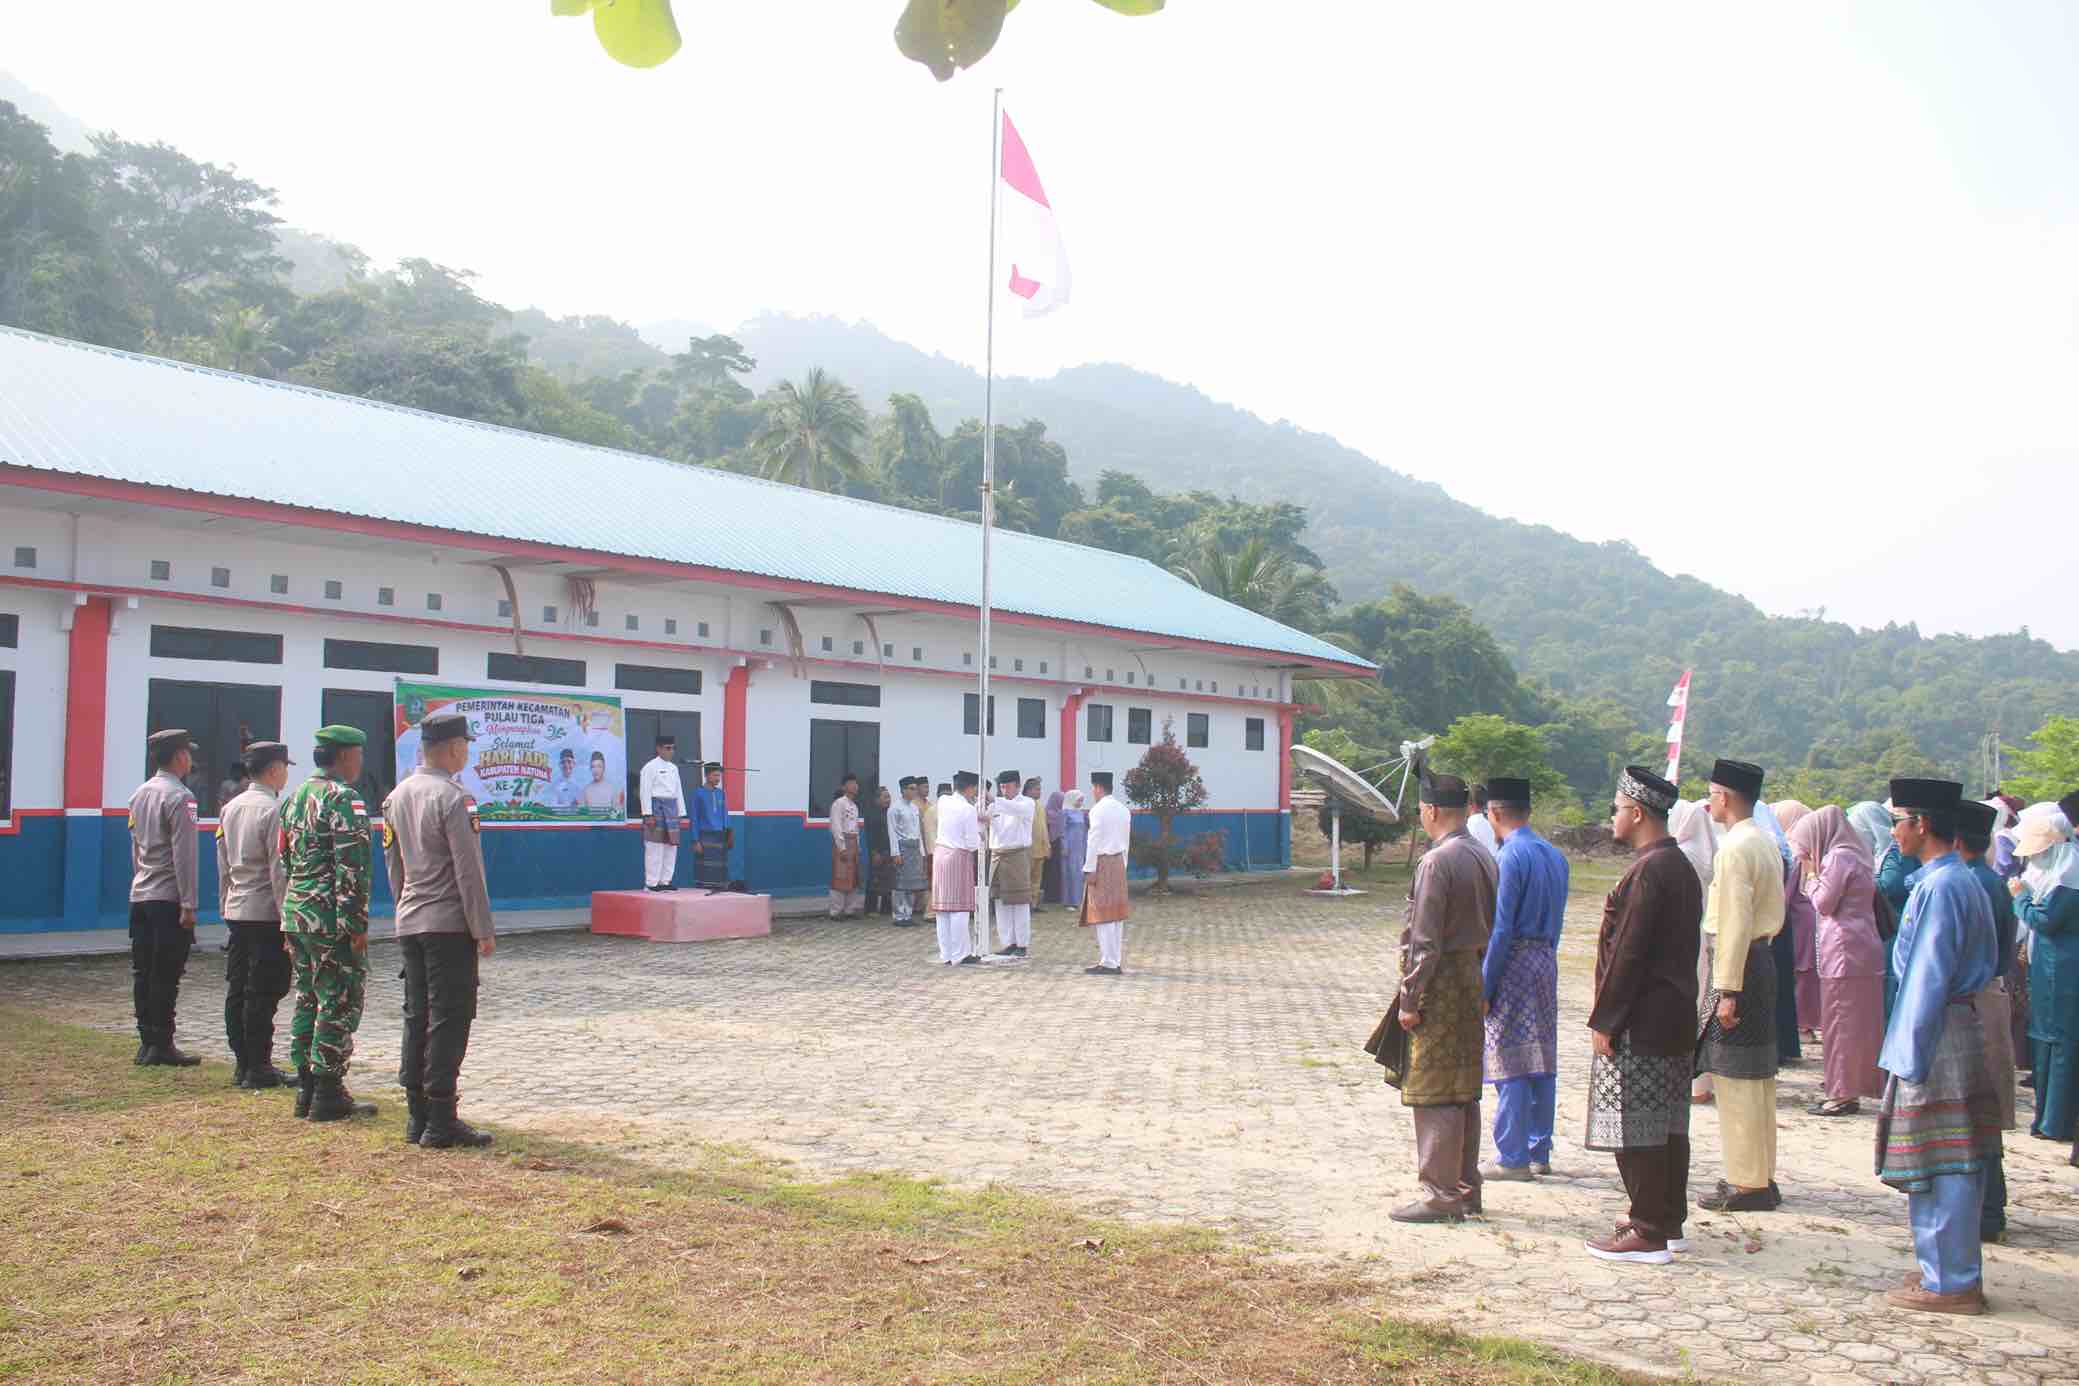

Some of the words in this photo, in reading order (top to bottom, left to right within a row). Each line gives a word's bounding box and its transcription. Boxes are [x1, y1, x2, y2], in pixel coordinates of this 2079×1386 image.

[456, 700, 514, 713] PEMERINTAH
[516, 702, 570, 718] KECAMATAN
[484, 711, 519, 723] PULAU
[521, 712, 545, 725] TIGA
[492, 736, 535, 751] Selamat
[480, 751, 515, 768] HARI
